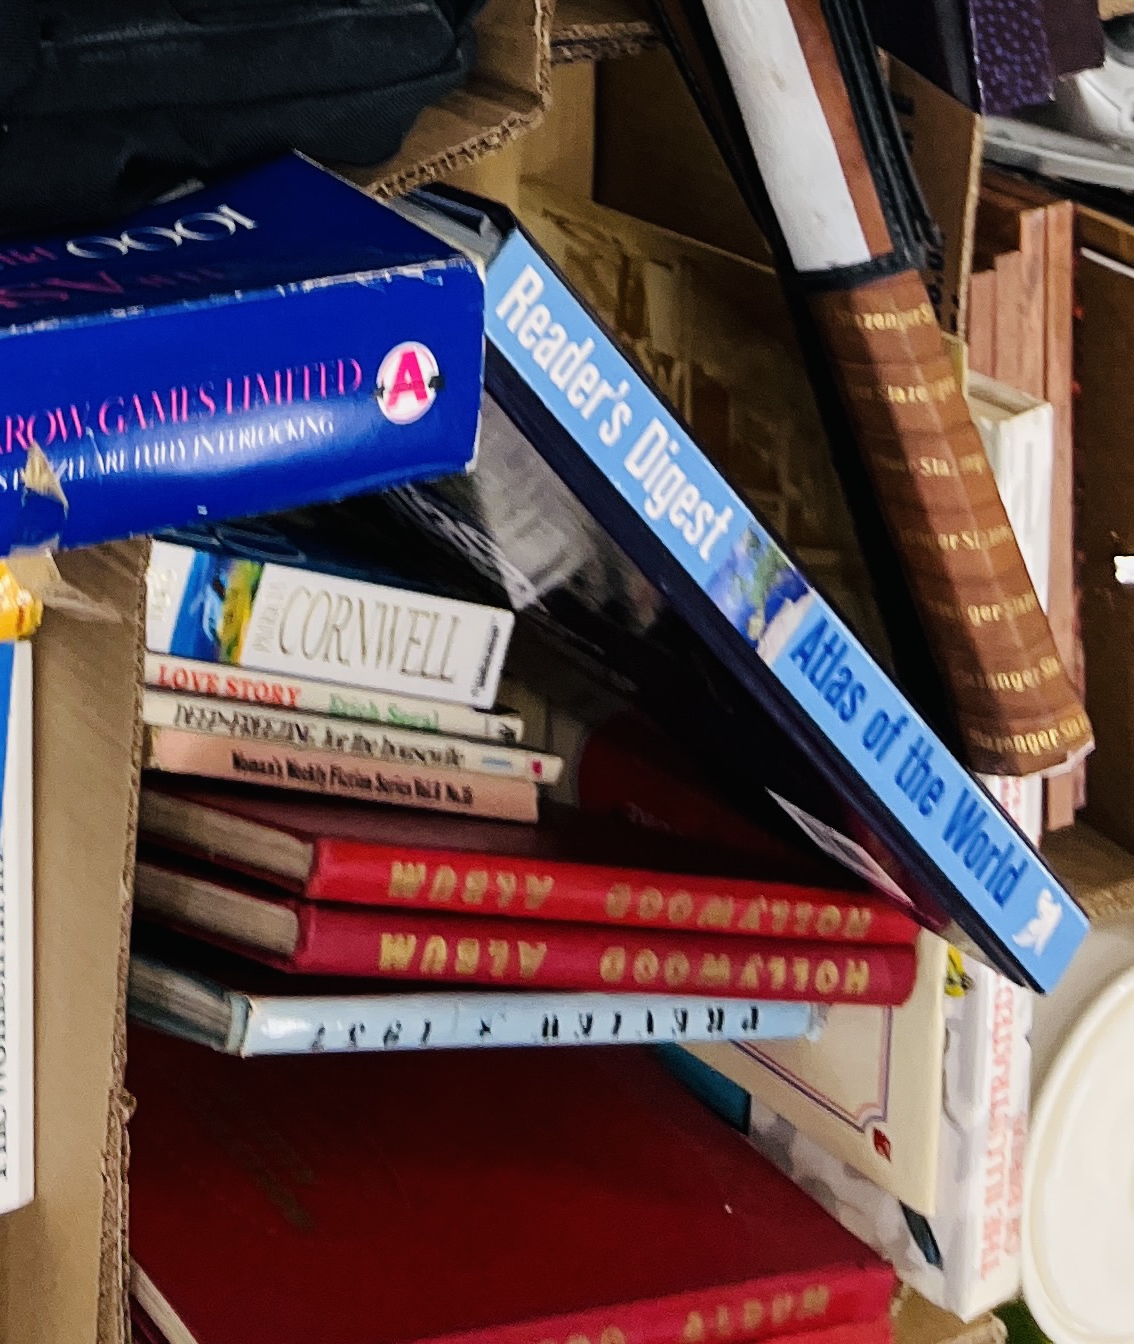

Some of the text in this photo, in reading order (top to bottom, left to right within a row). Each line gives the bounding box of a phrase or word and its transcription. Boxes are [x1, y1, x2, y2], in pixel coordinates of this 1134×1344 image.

[66, 202, 259, 261] 1000
[98, 382, 217, 436] GAMES
[225, 357, 364, 414] LIMITED
[495, 264, 1029, 909] Reader's Digest Atlas of the World
[278, 585, 460, 685] CORNWELL
[157, 663, 222, 697] LOVE
[227, 674, 302, 709] STORY
[387, 860, 875, 941] HOLLYWOOD ALBUM
[377, 932, 872, 996] HOLLYWOOD ALBUM
